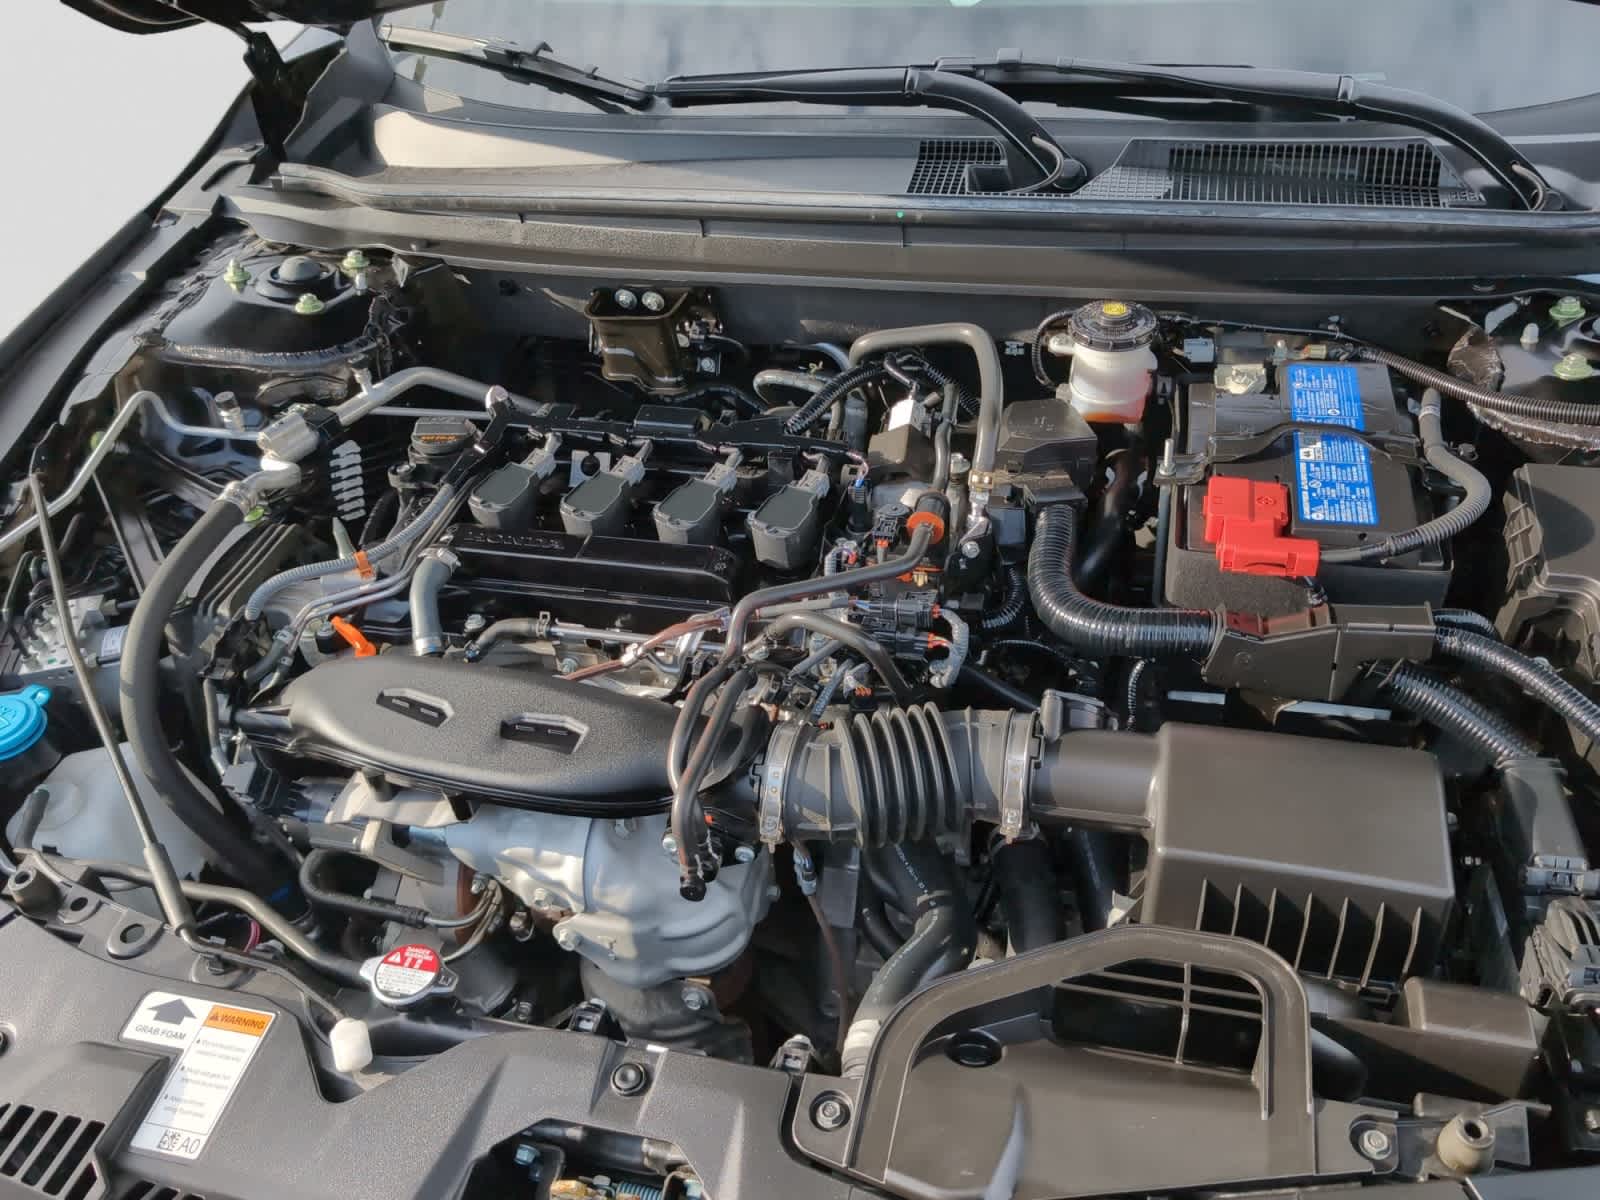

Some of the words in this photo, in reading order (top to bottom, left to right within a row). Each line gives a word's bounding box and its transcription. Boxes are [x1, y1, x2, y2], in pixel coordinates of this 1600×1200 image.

[221, 1014, 266, 1030] WARNING
[135, 1024, 160, 1036] GRAB
[160, 1029, 187, 1040] FOAM
